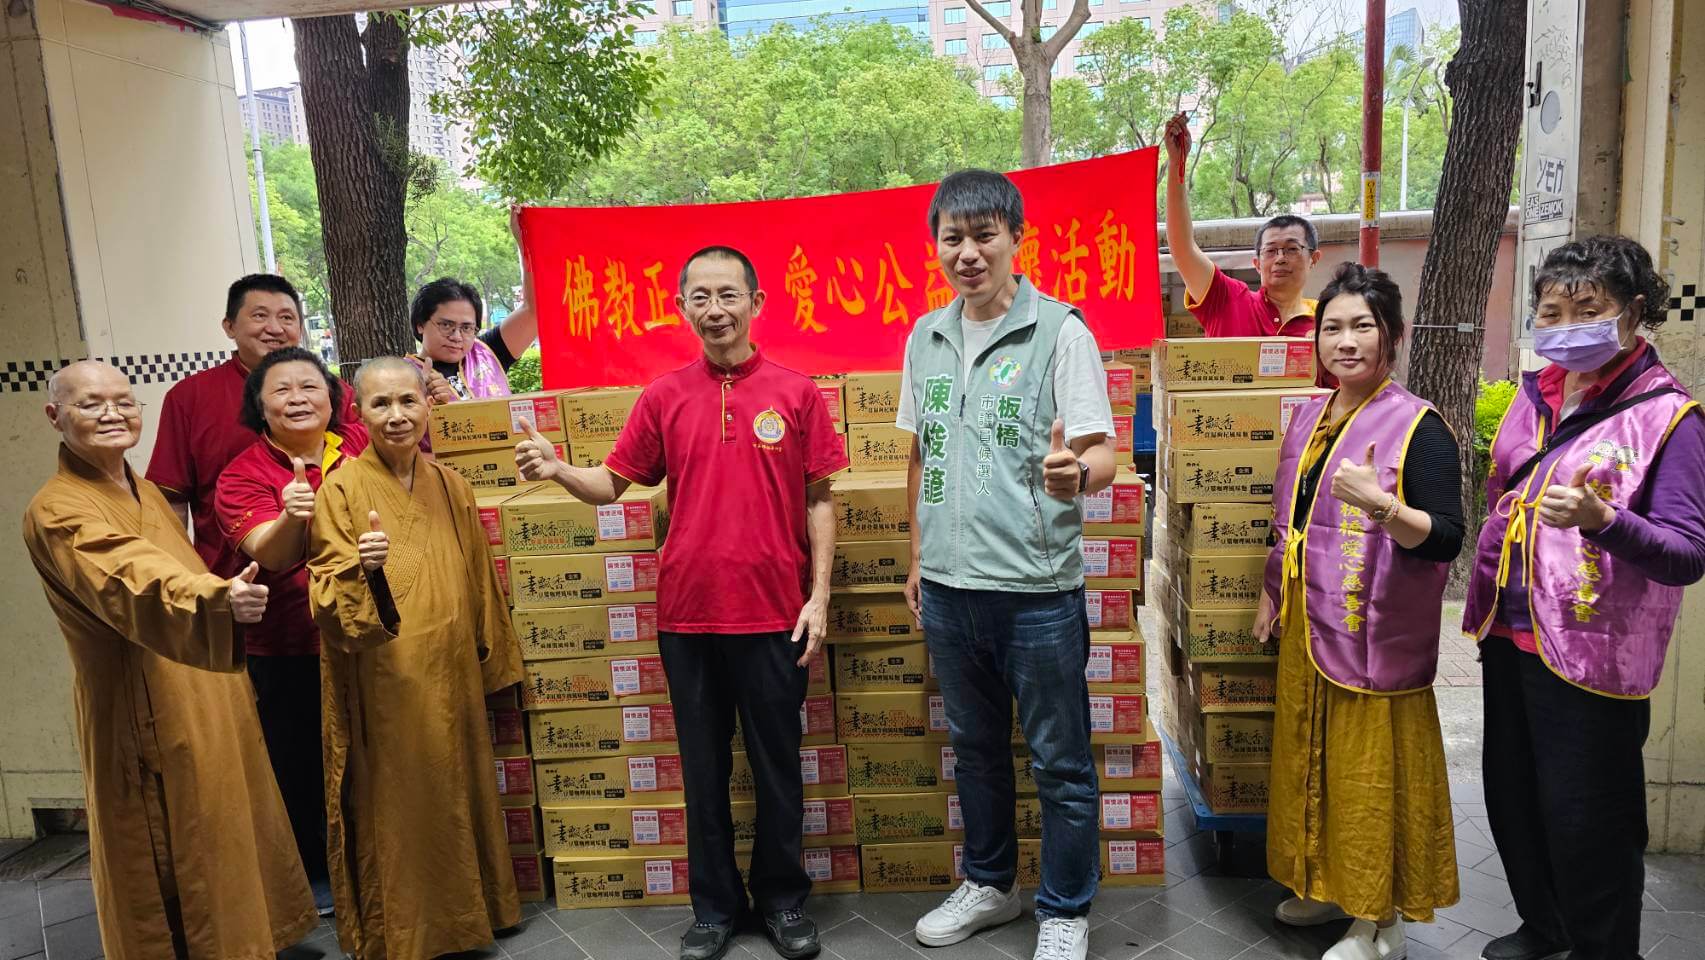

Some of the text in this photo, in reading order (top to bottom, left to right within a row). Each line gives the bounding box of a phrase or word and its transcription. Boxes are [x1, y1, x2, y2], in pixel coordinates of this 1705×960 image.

[562, 254, 680, 341] 佛教正
[921, 374, 953, 505] 陳俊諺
[976, 394, 995, 496] 市議員候選人
[996, 395, 1021, 448] 板橋
